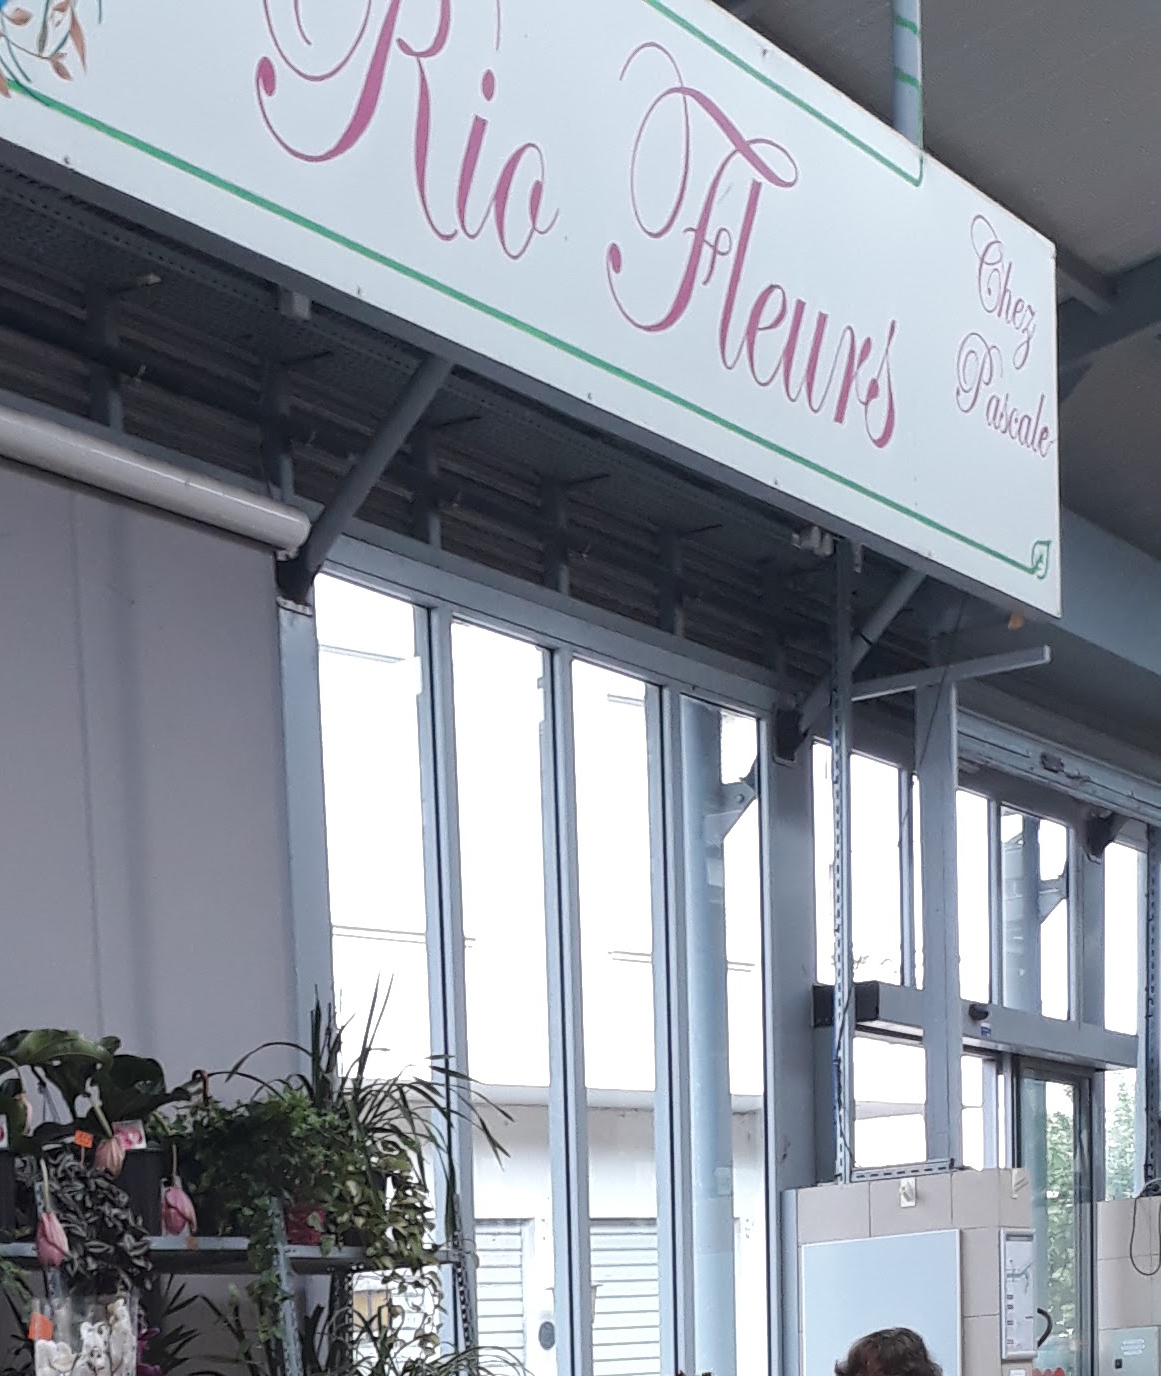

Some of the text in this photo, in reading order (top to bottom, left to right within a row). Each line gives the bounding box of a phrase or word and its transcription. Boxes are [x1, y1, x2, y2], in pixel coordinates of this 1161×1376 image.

[256, 0, 896, 449] Rio Fleurs
[970, 213, 1037, 371] Chez
[956, 332, 1055, 458] Pascale
